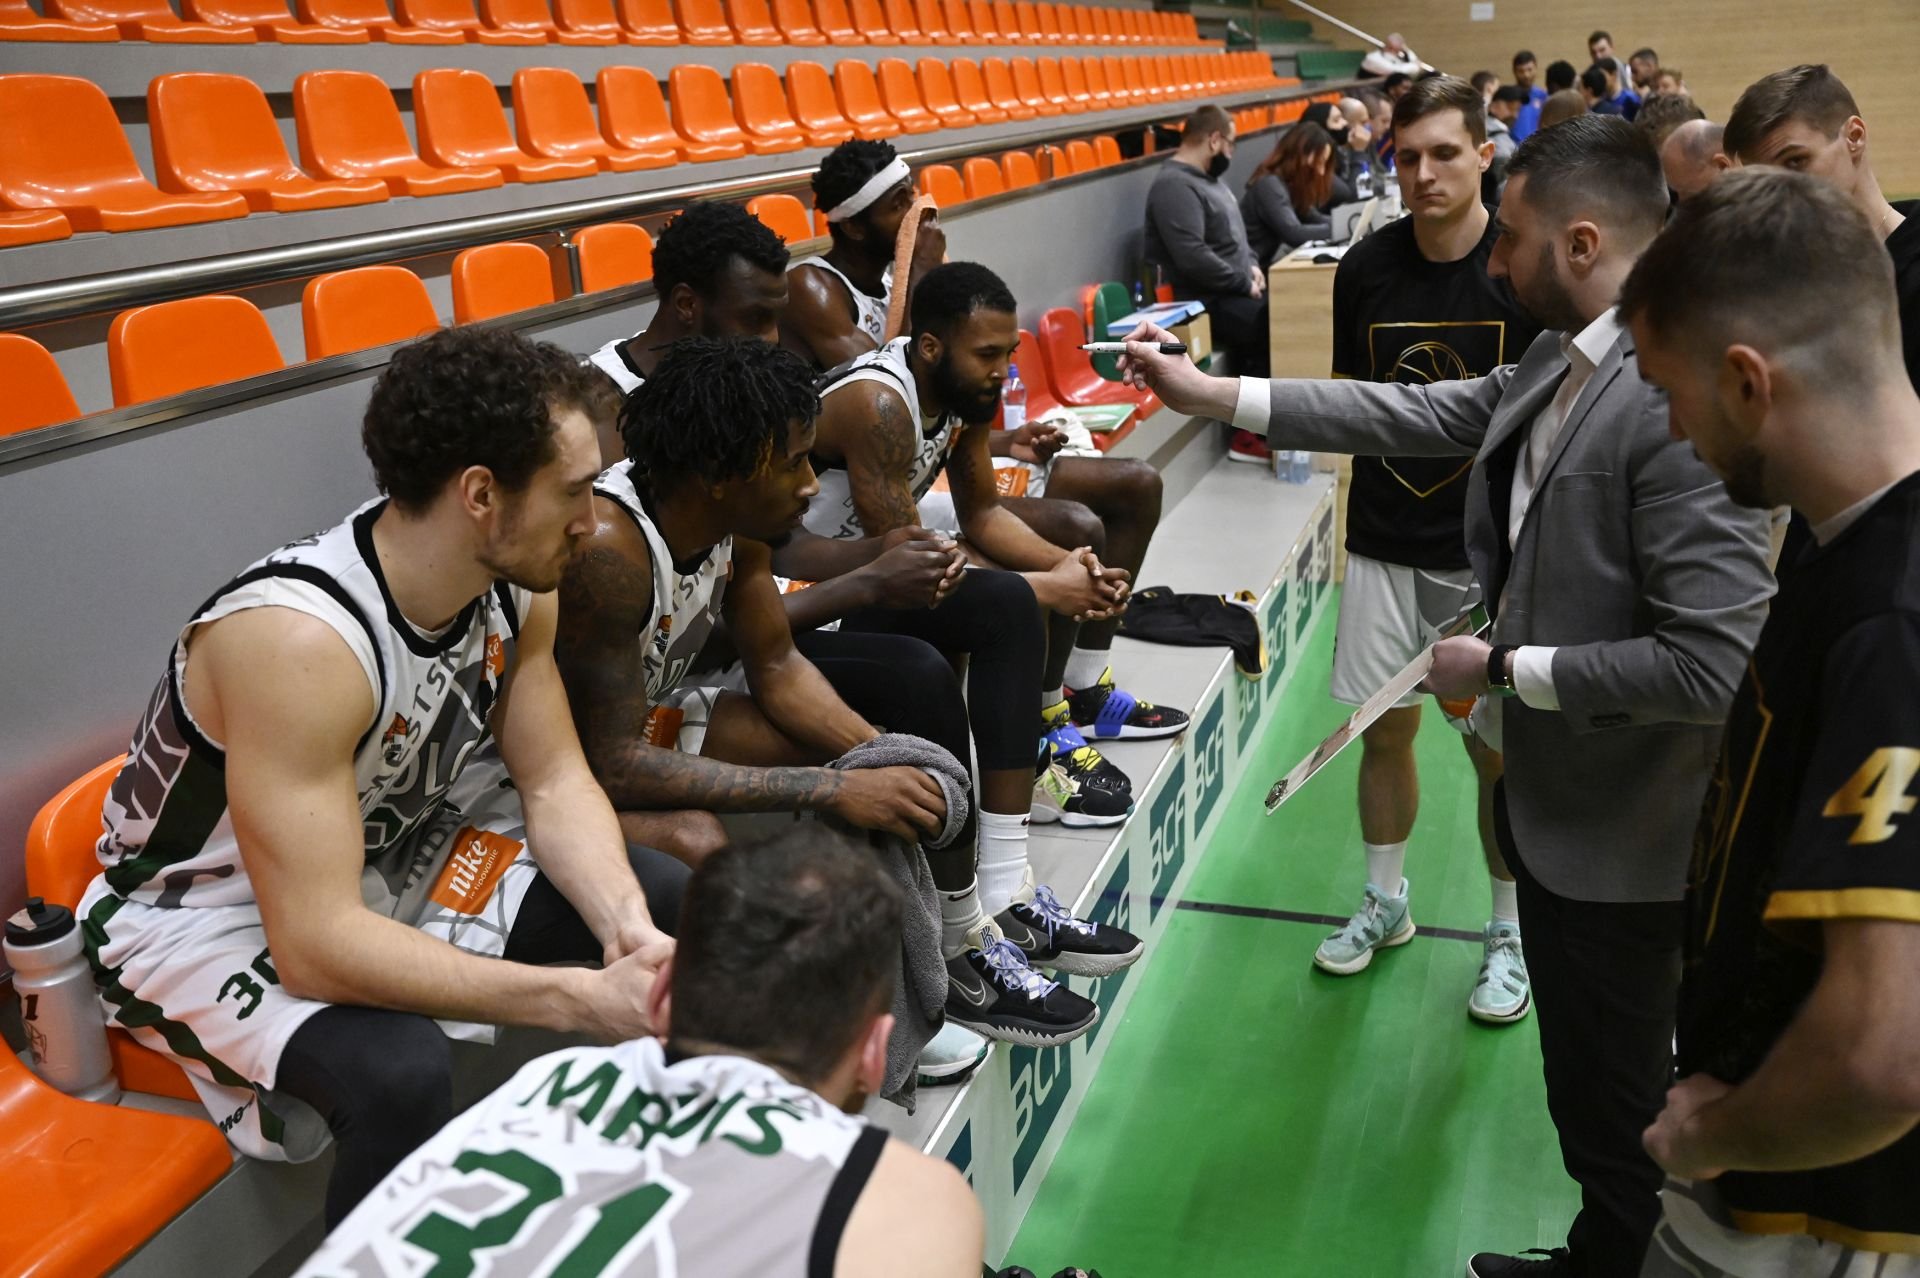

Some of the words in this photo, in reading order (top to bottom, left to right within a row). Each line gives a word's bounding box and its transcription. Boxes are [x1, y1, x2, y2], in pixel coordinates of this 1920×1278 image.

[1194, 719, 1224, 807] BCF
[1822, 745, 1920, 846] 4
[1150, 787, 1185, 889] BCF
